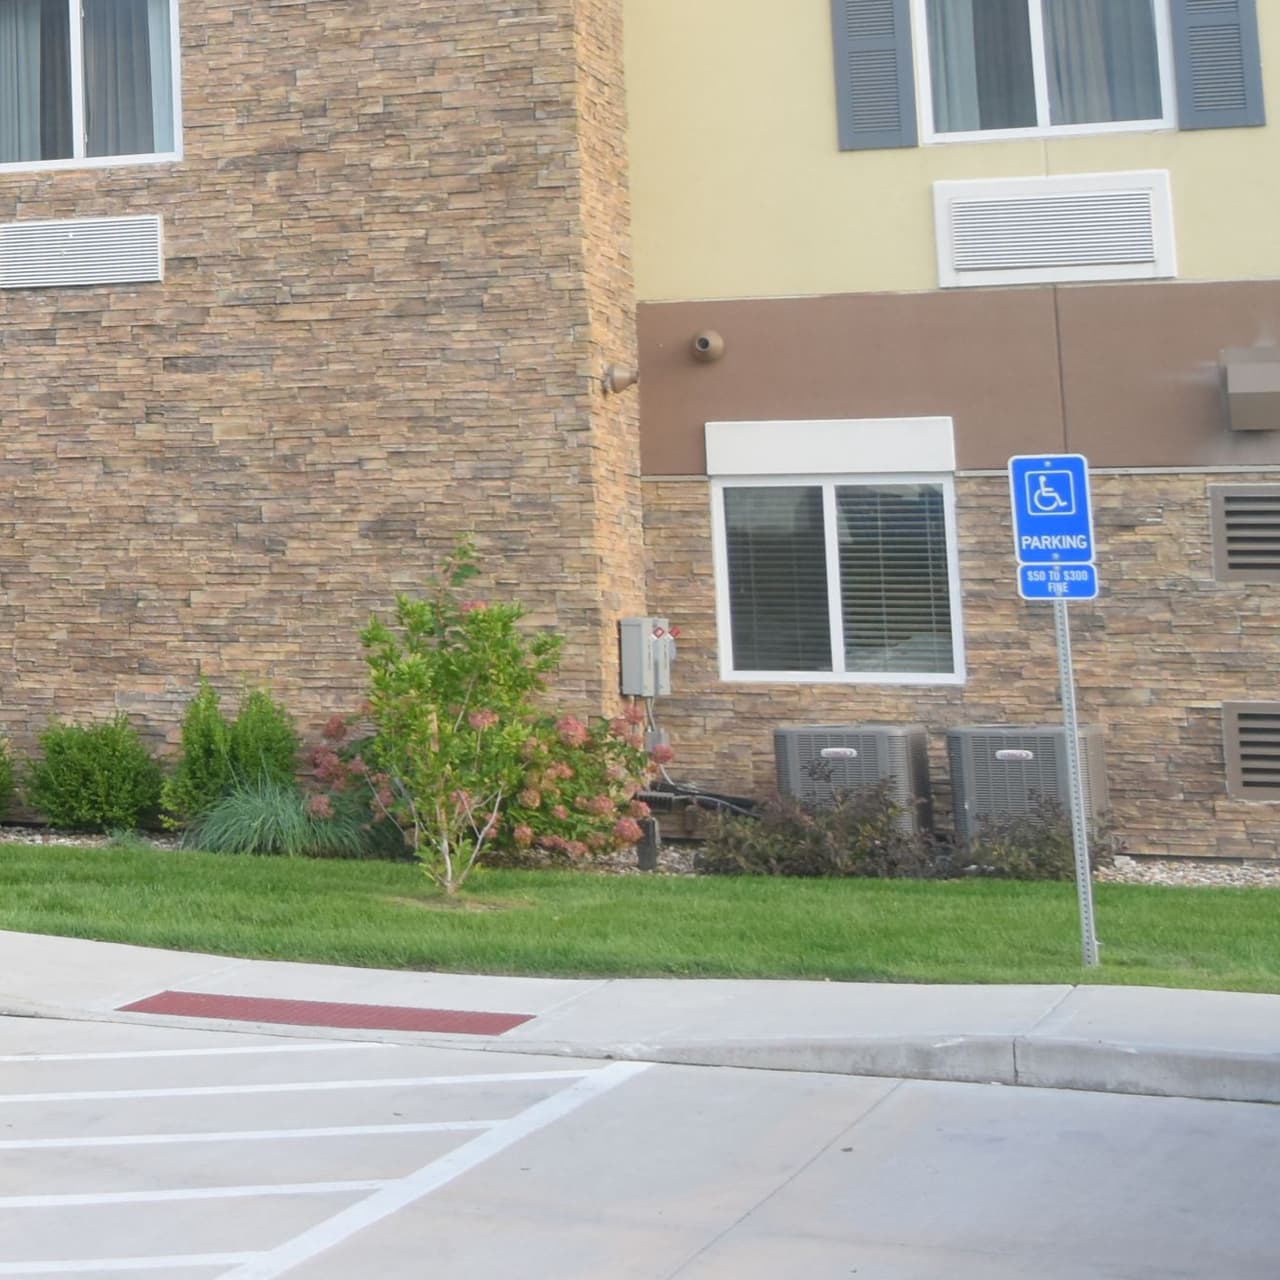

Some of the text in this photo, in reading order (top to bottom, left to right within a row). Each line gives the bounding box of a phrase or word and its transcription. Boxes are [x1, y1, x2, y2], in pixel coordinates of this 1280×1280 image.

[1021, 535, 1088, 550] PARKING
[1027, 570, 1088, 581] $50 TO $300
[1048, 582, 1069, 593] FINE
